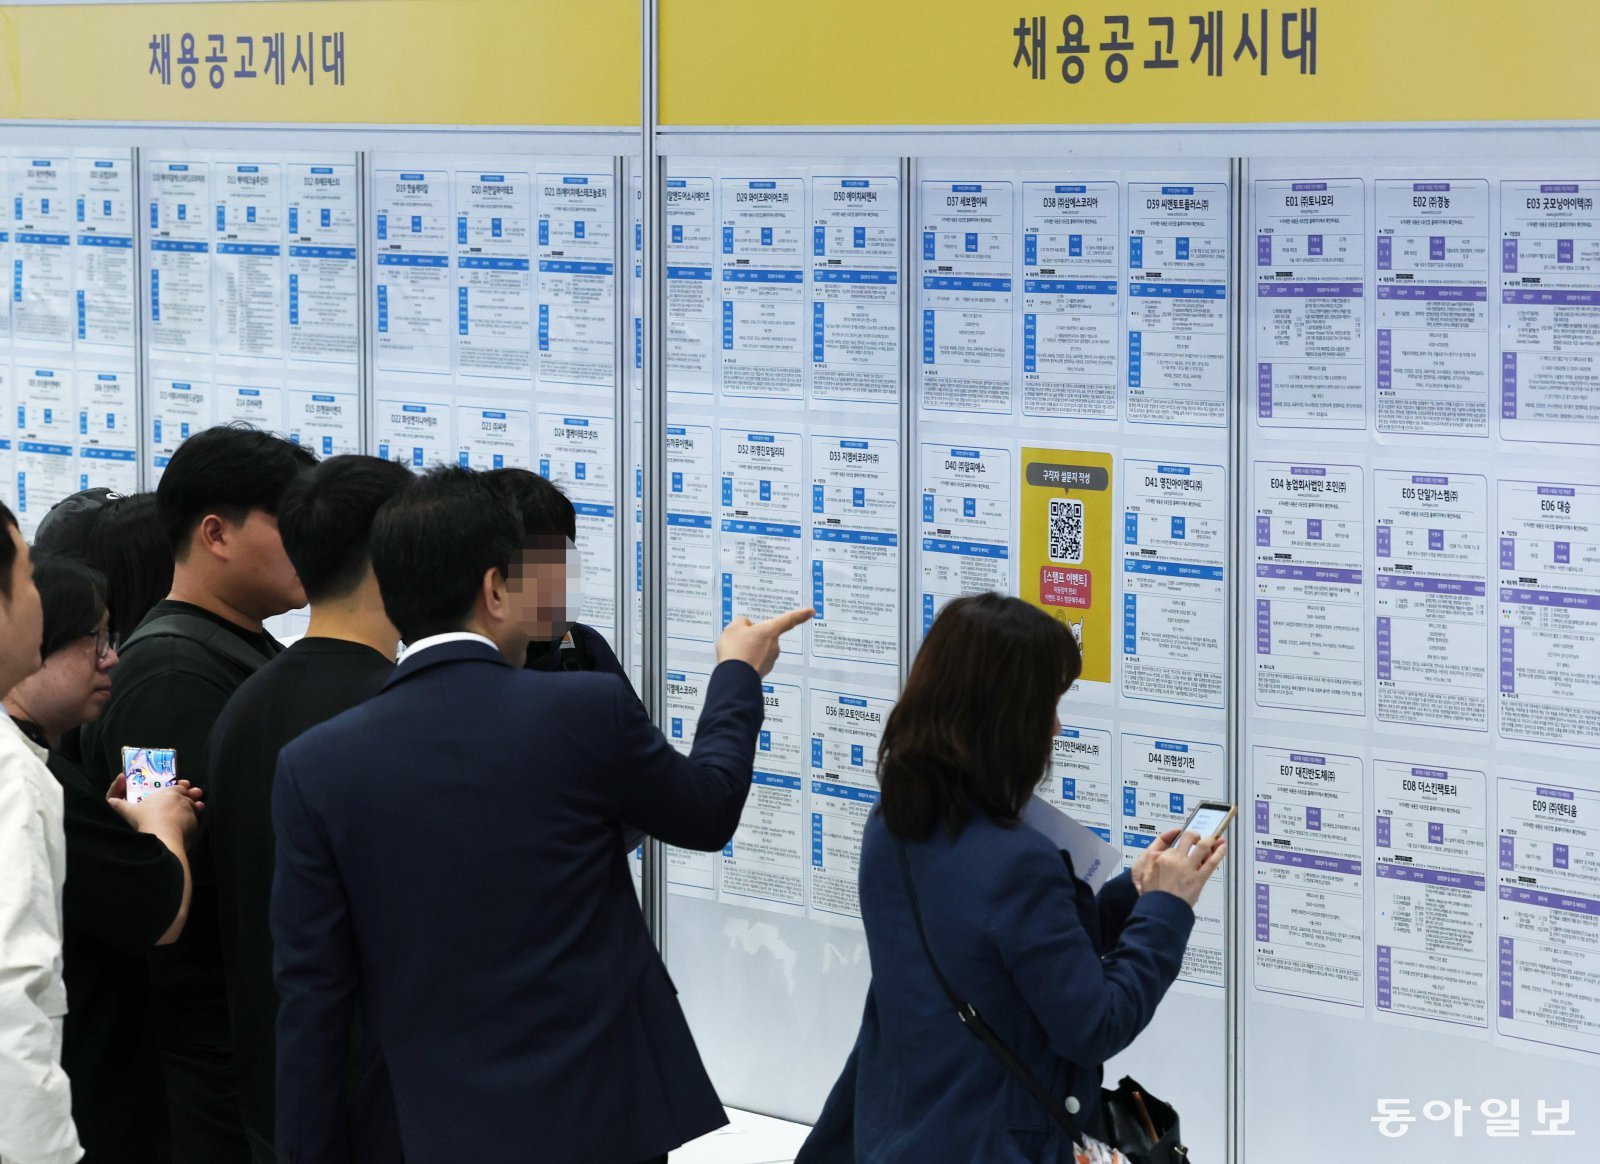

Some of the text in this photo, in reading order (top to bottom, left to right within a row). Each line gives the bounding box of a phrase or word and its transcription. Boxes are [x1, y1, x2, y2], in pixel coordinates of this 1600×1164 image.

[1013, 7, 1317, 84] 채용공고게시대
[149, 32, 345, 89] 채용공고게시대
[946, 196, 958, 207] D37
[1044, 198, 1056, 208] D38
[1146, 199, 1160, 210] D39
[1286, 196, 1298, 206] E01
[1413, 196, 1426, 207] E02
[1526, 198, 1540, 209] E03
[945, 460, 956, 470] D40
[1042, 470, 1090, 484] 구직자 설문지 작성
[1144, 476, 1158, 488] D41
[1270, 478, 1284, 488] E04
[1286, 479, 1324, 492] 농업회사법인
[1402, 488, 1416, 499] E05
[1541, 500, 1571, 514] E06 대승
[1066, 572, 1088, 586] 이벤트]
[764, 697, 780, 706] 오오토
[826, 706, 837, 716] D36
[1148, 752, 1162, 764] D44
[1280, 765, 1294, 776] E07
[1402, 780, 1457, 796] E08 더스킨팩토리
[1532, 800, 1546, 812] E09
